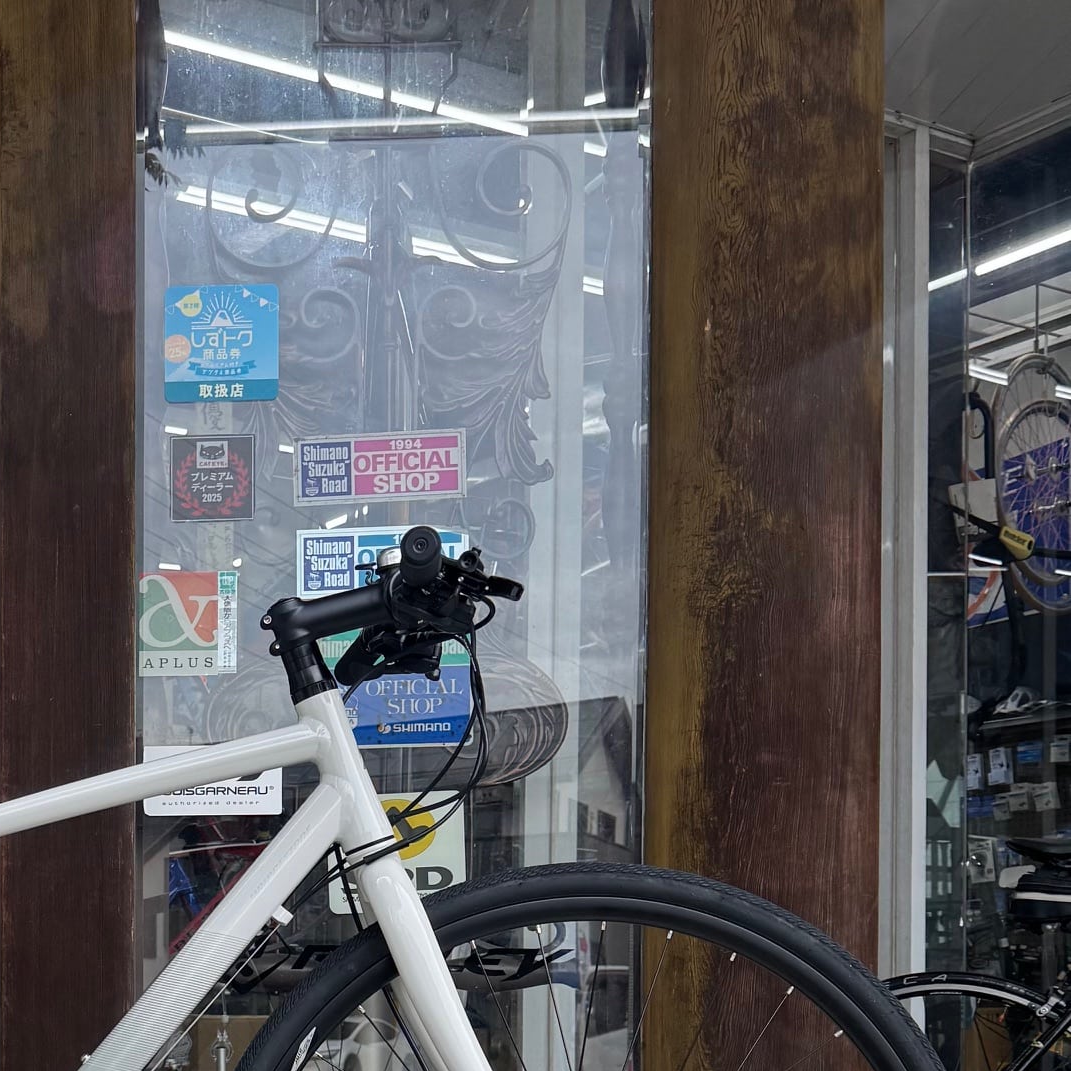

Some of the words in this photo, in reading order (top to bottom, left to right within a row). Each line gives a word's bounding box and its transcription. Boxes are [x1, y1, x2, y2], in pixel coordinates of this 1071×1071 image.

[191, 328, 253, 348] しずトク
[203, 348, 241, 360] 商品券
[199, 383, 244, 398] 取扱店
[389, 439, 422, 450] 1994
[303, 446, 348, 462] Shimano
[353, 450, 459, 473] OFFICIAL
[191, 472, 234, 481] プレミアム
[373, 472, 440, 494] SHOP
[191, 482, 234, 492] ディーラー
[321, 477, 348, 493] Road
[202, 494, 222, 502] 2025
[306, 540, 351, 556] Shimano
[324, 571, 350, 587] Road
[142, 657, 214, 668] APLUS
[365, 678, 464, 696] OFFICIAL
[387, 698, 443, 715] SHOP
[393, 722, 451, 733] SHIMANO
